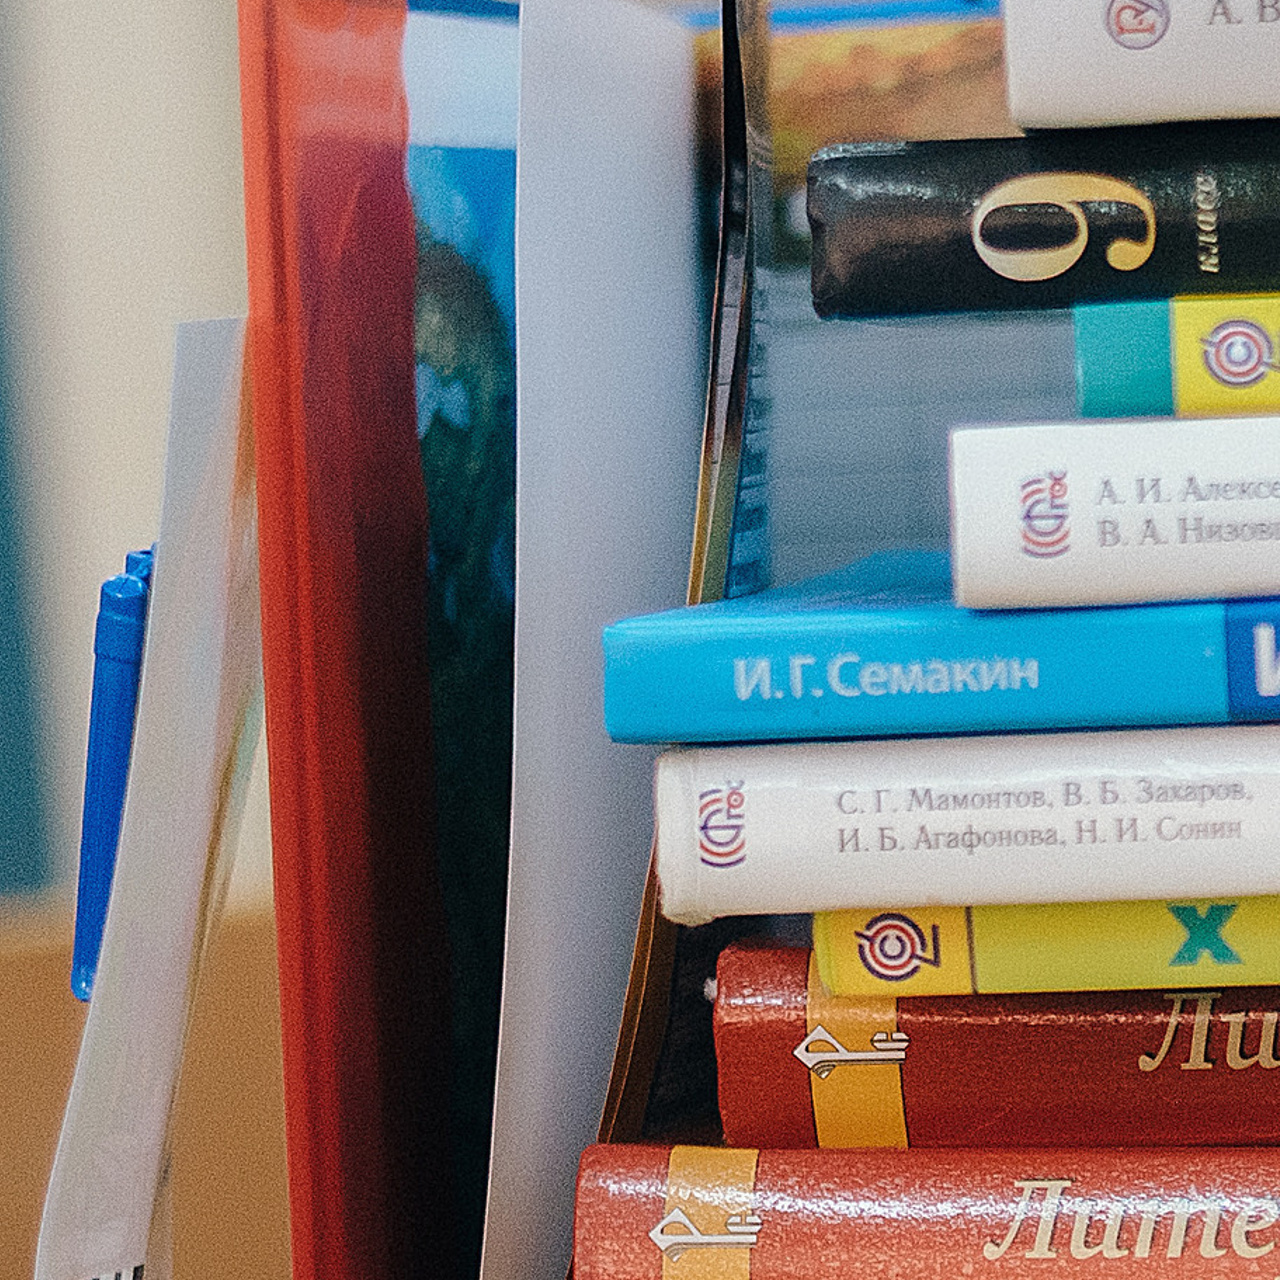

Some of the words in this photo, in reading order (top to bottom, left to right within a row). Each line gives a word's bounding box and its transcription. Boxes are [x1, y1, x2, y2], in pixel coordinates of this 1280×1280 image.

[972, 172, 1157, 283] 9
[1097, 478, 1126, 506] А.
[1134, 477, 1172, 505] И.
[1100, 520, 1127, 548] В.
[1139, 519, 1169, 547] А.
[836, 789, 865, 816] С.
[873, 788, 900, 815] Г.
[907, 783, 1055, 816] Мамонтов,
[1062, 779, 1092, 809] В.
[1098, 778, 1128, 807] Б.
[1136, 775, 1254, 809] Захаров,
[837, 827, 870, 854] И.
[877, 826, 907, 852] Б.
[914, 822, 1068, 858] Агафонова,
[1075, 817, 1109, 845] Н.
[1114, 816, 1150, 843] И.
[1156, 813, 1242, 843] Сонин
